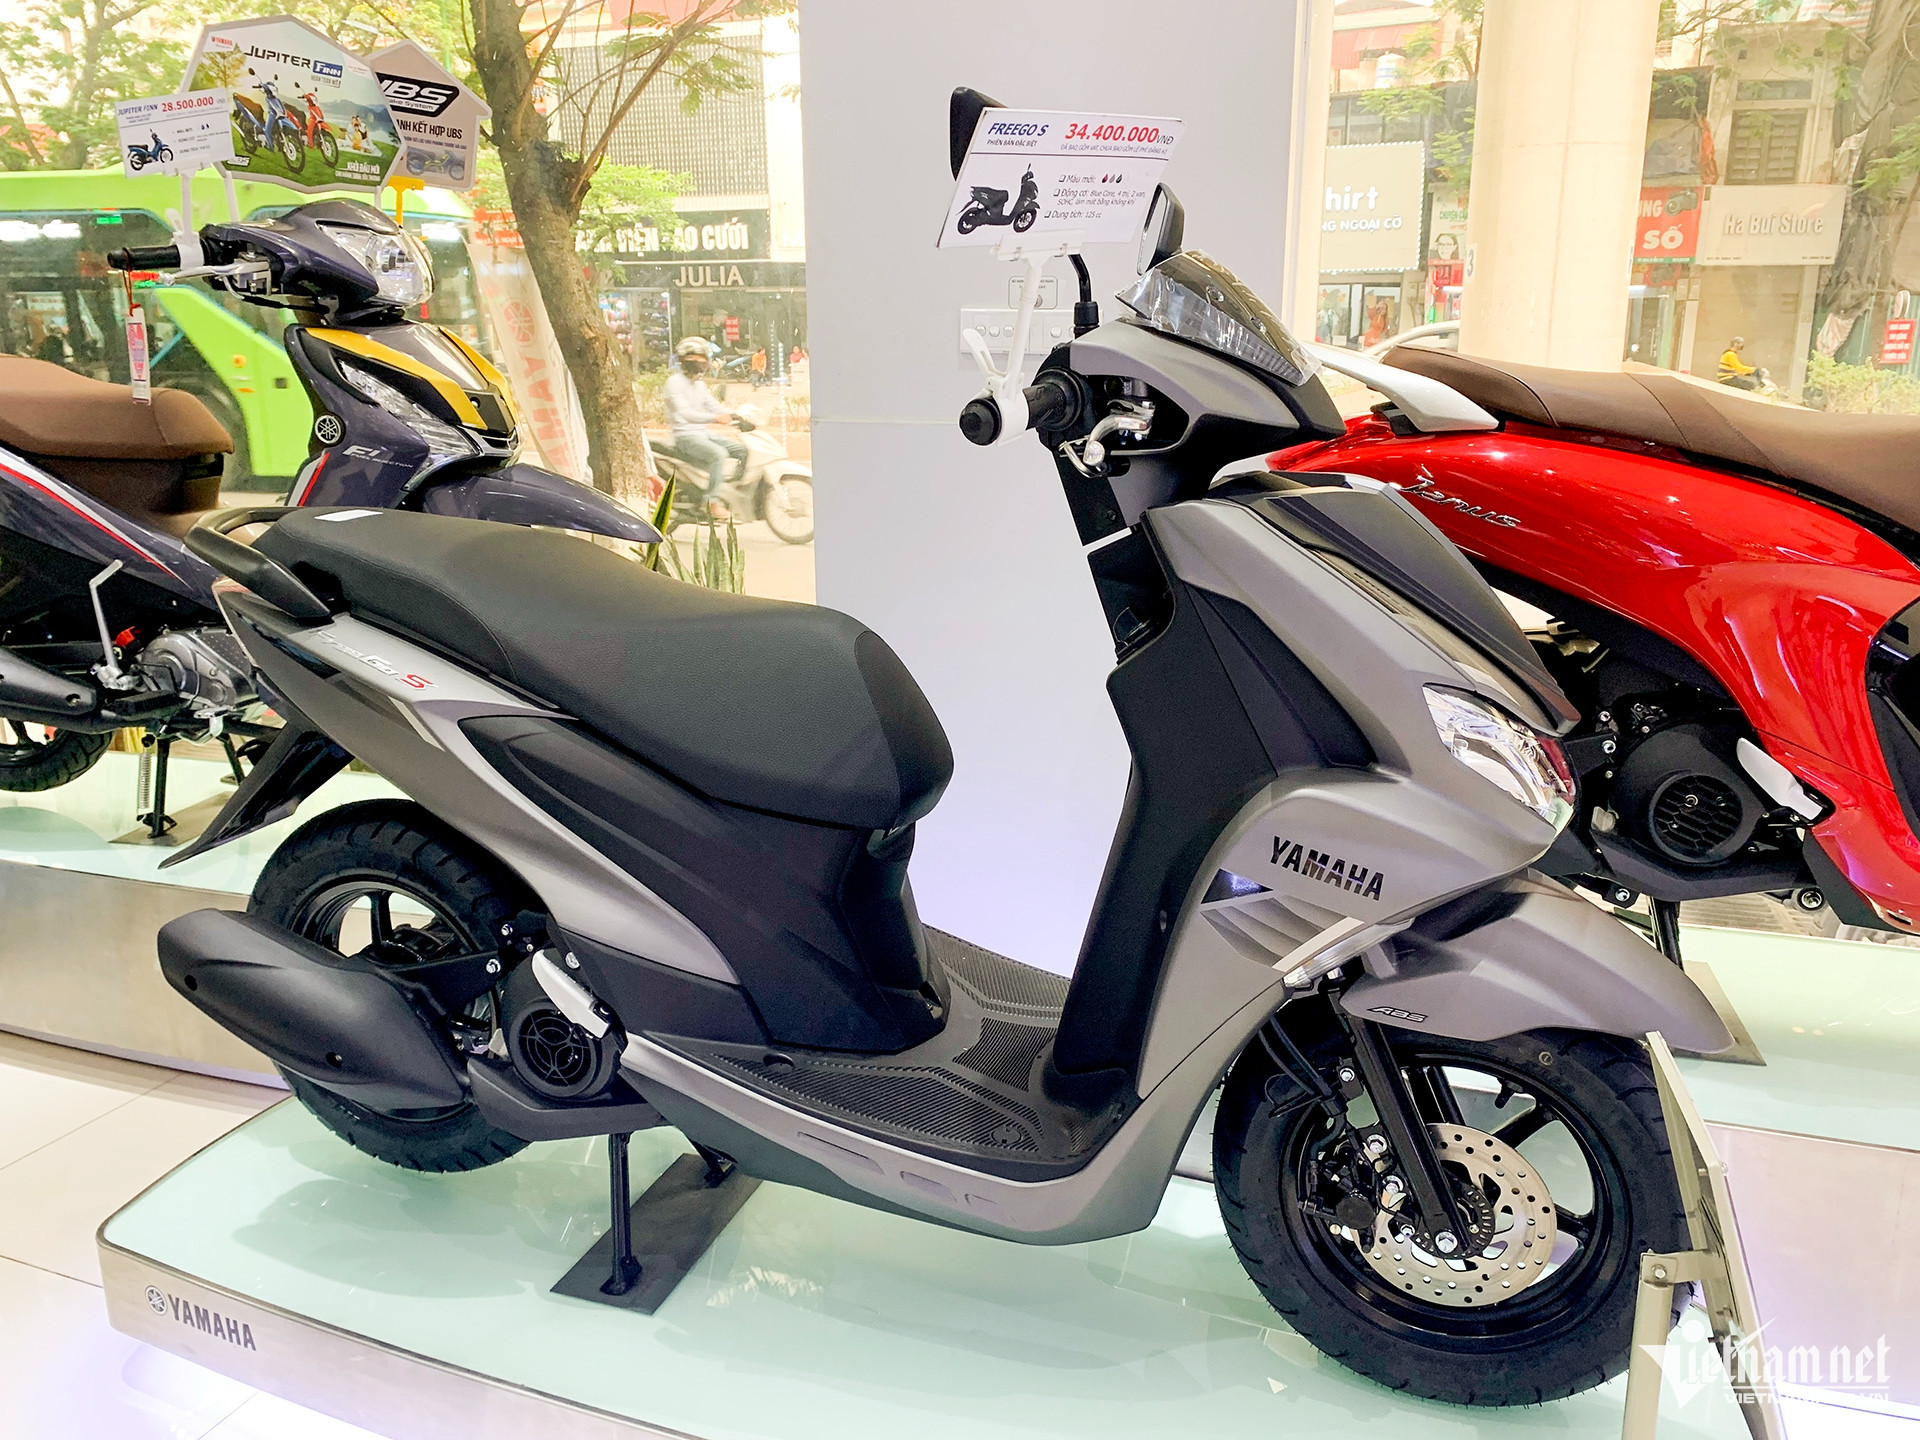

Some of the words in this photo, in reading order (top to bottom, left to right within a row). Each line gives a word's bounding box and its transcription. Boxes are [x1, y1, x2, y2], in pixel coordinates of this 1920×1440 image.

[244, 45, 311, 69] JUPITER
[117, 106, 142, 116] JUPITER
[161, 96, 214, 113] 28.500.000
[412, 121, 428, 133] KẾT
[429, 124, 446, 137] HỢP
[446, 127, 463, 139] UBS
[988, 122, 1038, 136] FREEGO
[1037, 124, 1049, 136] S
[1065, 123, 1160, 144] 34.400.000
[1052, 211, 1069, 220] Dung
[1340, 219, 1380, 233] NGOẠI
[1779, 212, 1824, 235] Store
[701, 216, 749, 251] CƯỚI
[1642, 223, 1683, 250] SỐ
[675, 264, 745, 288] JULIA
[518, 352, 575, 480] YAMA
[400, 674, 437, 690] S
[1270, 835, 1384, 901] YAMAHA
[1371, 1006, 1428, 1024] ABS
[168, 1293, 257, 1352] YAMAHA
